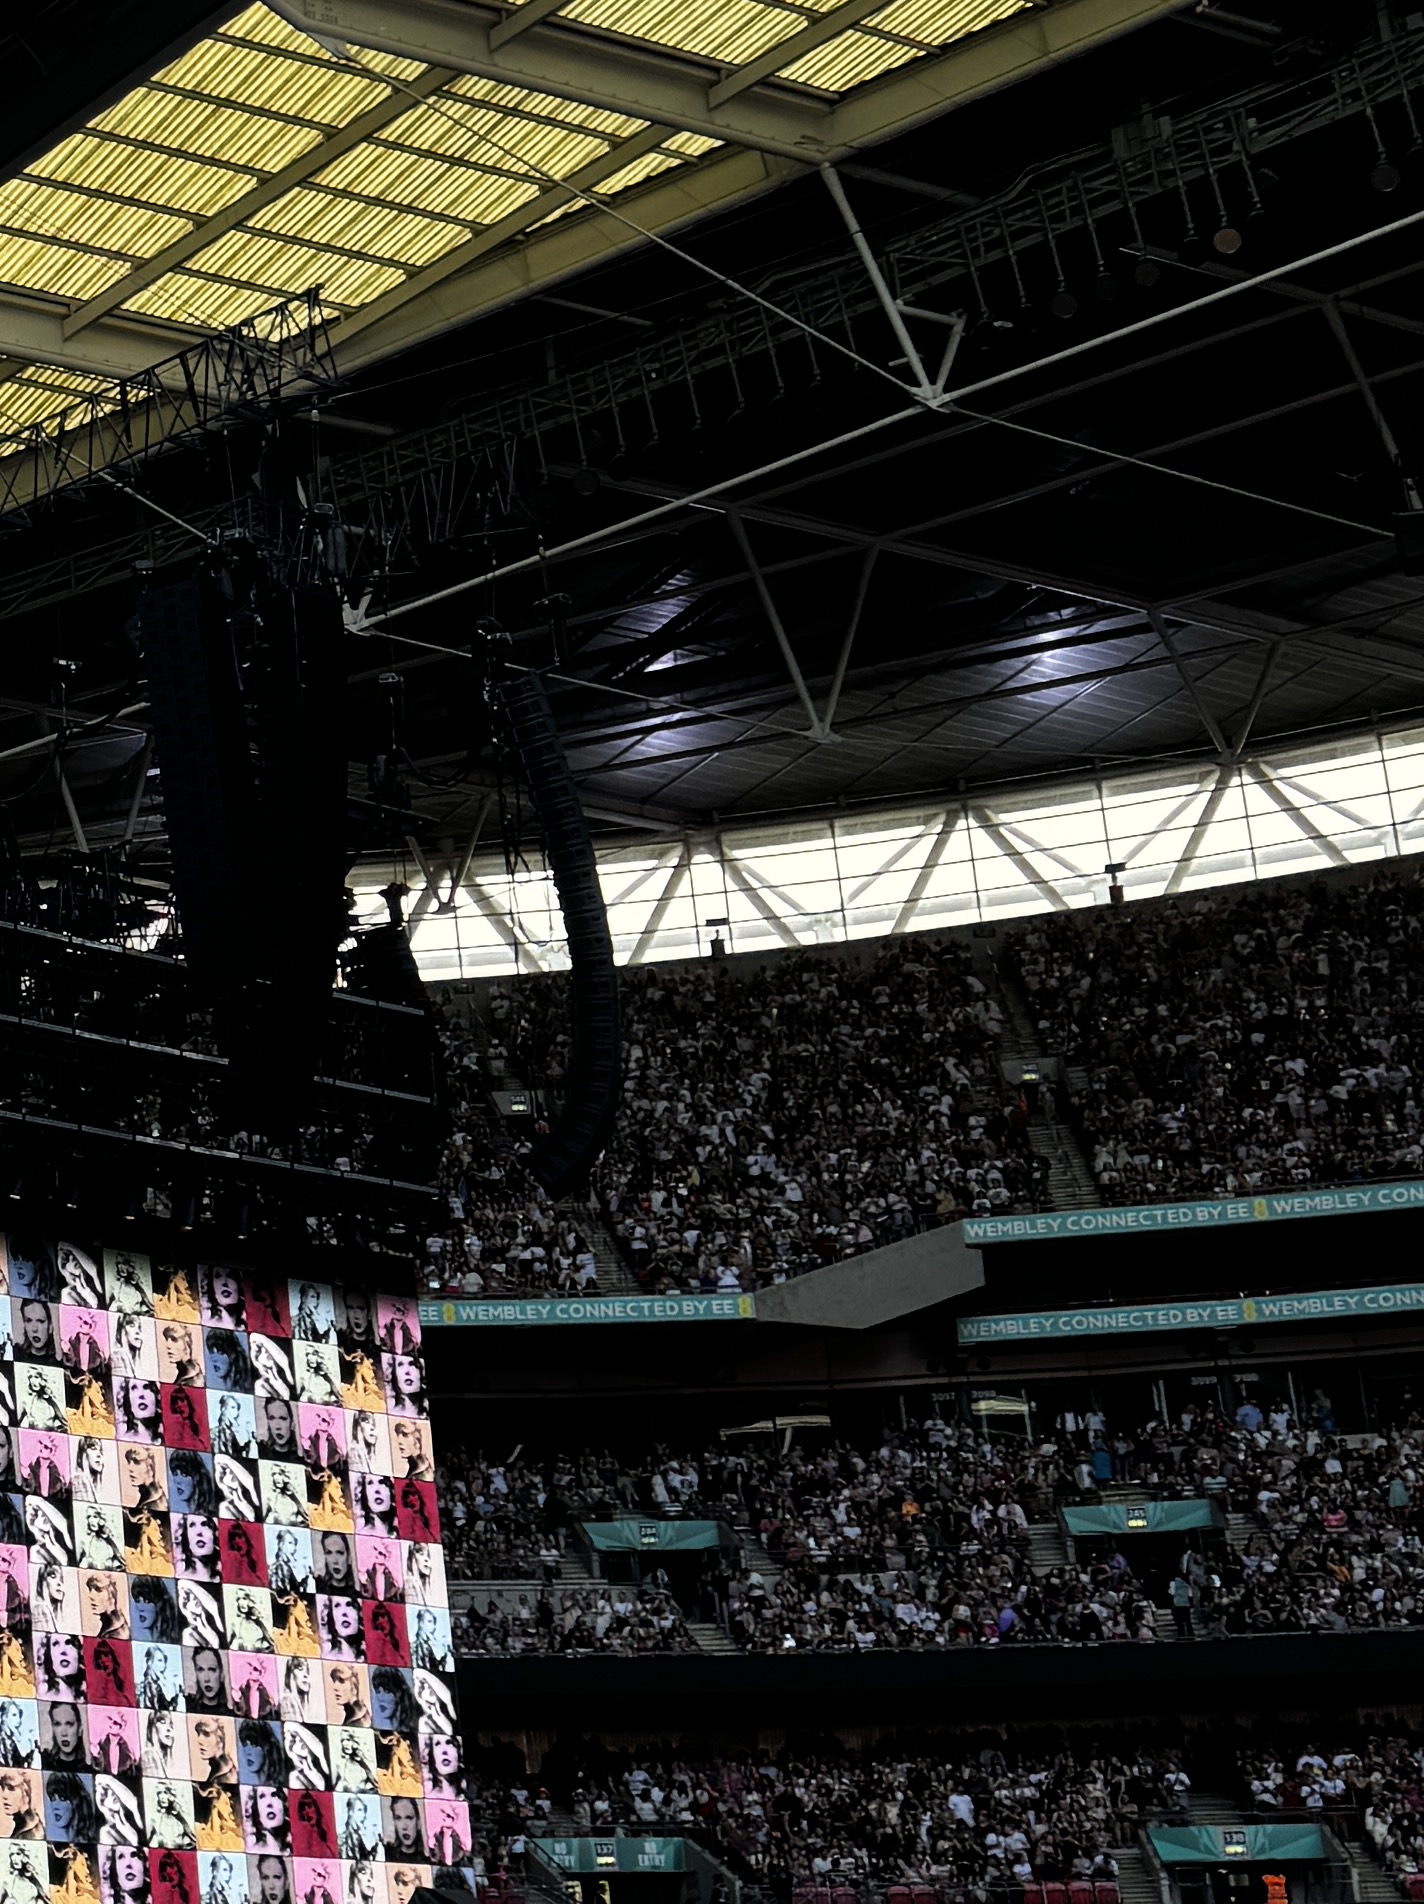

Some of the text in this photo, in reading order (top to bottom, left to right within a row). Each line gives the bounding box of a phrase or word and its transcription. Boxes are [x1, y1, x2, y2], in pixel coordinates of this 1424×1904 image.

[967, 1218, 1060, 1238] WEMBLEY
[1066, 1208, 1192, 1231] CONNECTED
[1196, 1205, 1222, 1221] BY
[1226, 1202, 1249, 1217] EE
[1273, 1191, 1372, 1213] WEMBLEY
[460, 1305, 551, 1321] WEMBLEY
[556, 1300, 679, 1317] CONNECTED
[682, 1300, 707, 1315] BY
[712, 1299, 733, 1314] EE
[960, 1317, 1054, 1337] WEMBLEY
[1058, 1309, 1182, 1331] CONNECTED
[1186, 1306, 1210, 1322] BY
[1216, 1304, 1238, 1320] EE
[1261, 1296, 1359, 1316] WEMBLEY
